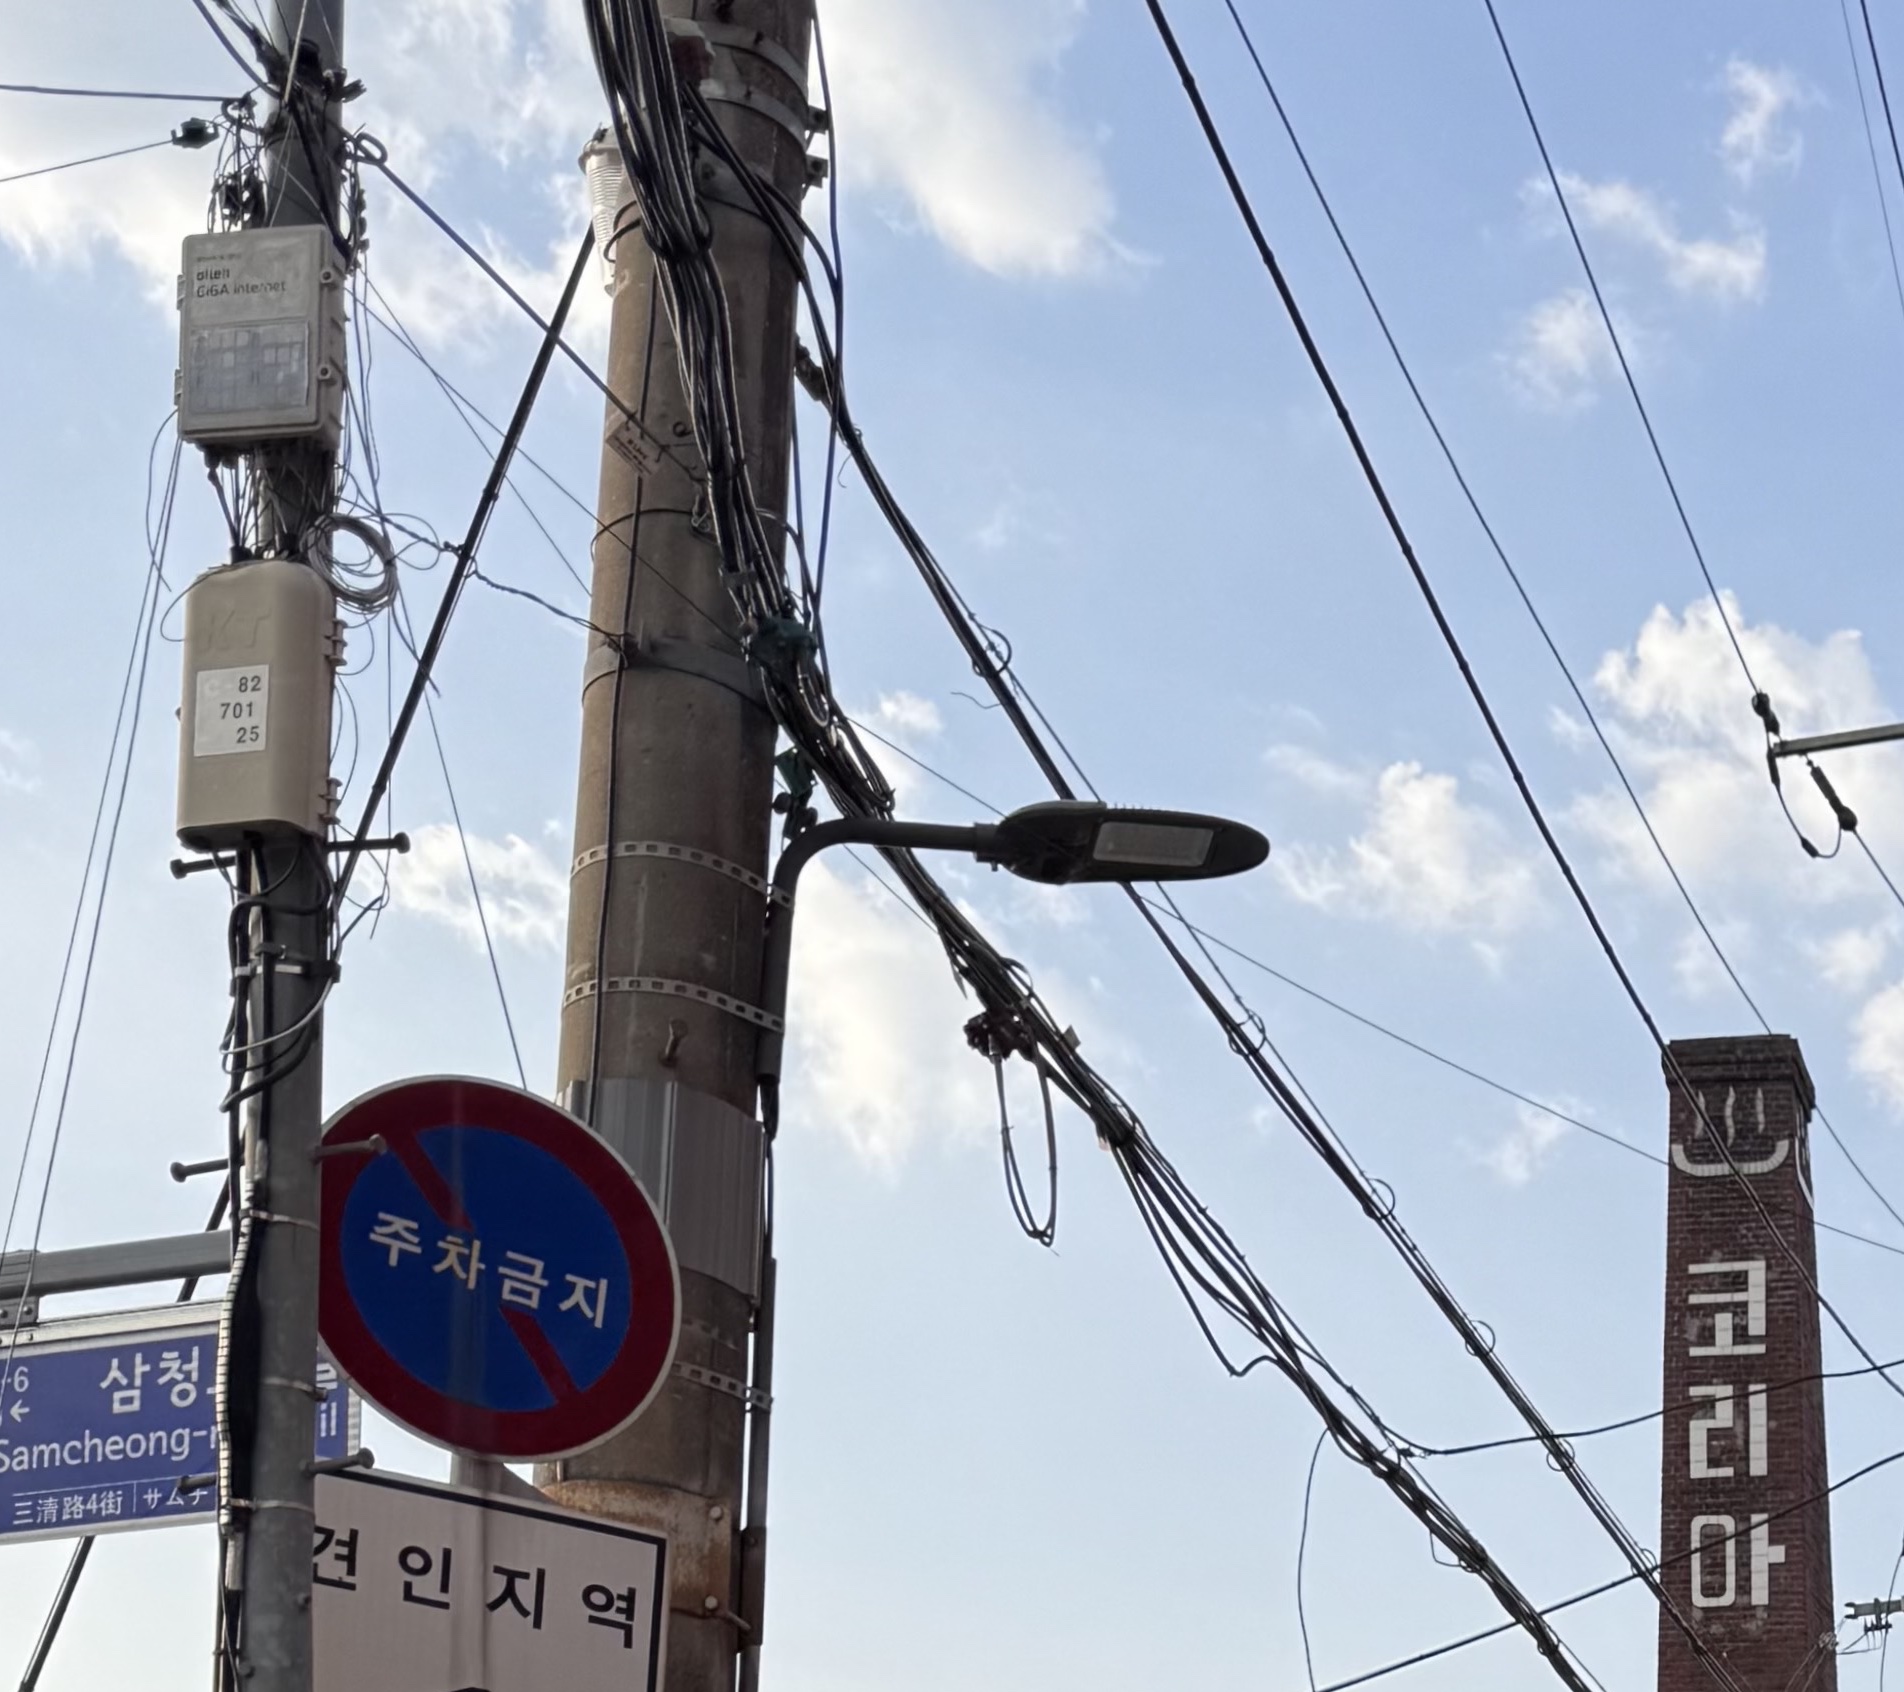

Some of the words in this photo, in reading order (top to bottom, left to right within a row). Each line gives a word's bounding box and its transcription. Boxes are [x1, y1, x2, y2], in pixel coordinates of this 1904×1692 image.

[220, 701, 254, 720] 701
[238, 675, 262, 693] 82
[236, 725, 260, 744] 25
[368, 1211, 607, 1328] 주차금지
[99, 1345, 217, 1415] 삼청
[1687, 1259, 1787, 1608] 코리아
[312, 1525, 636, 1649] 견인지역
